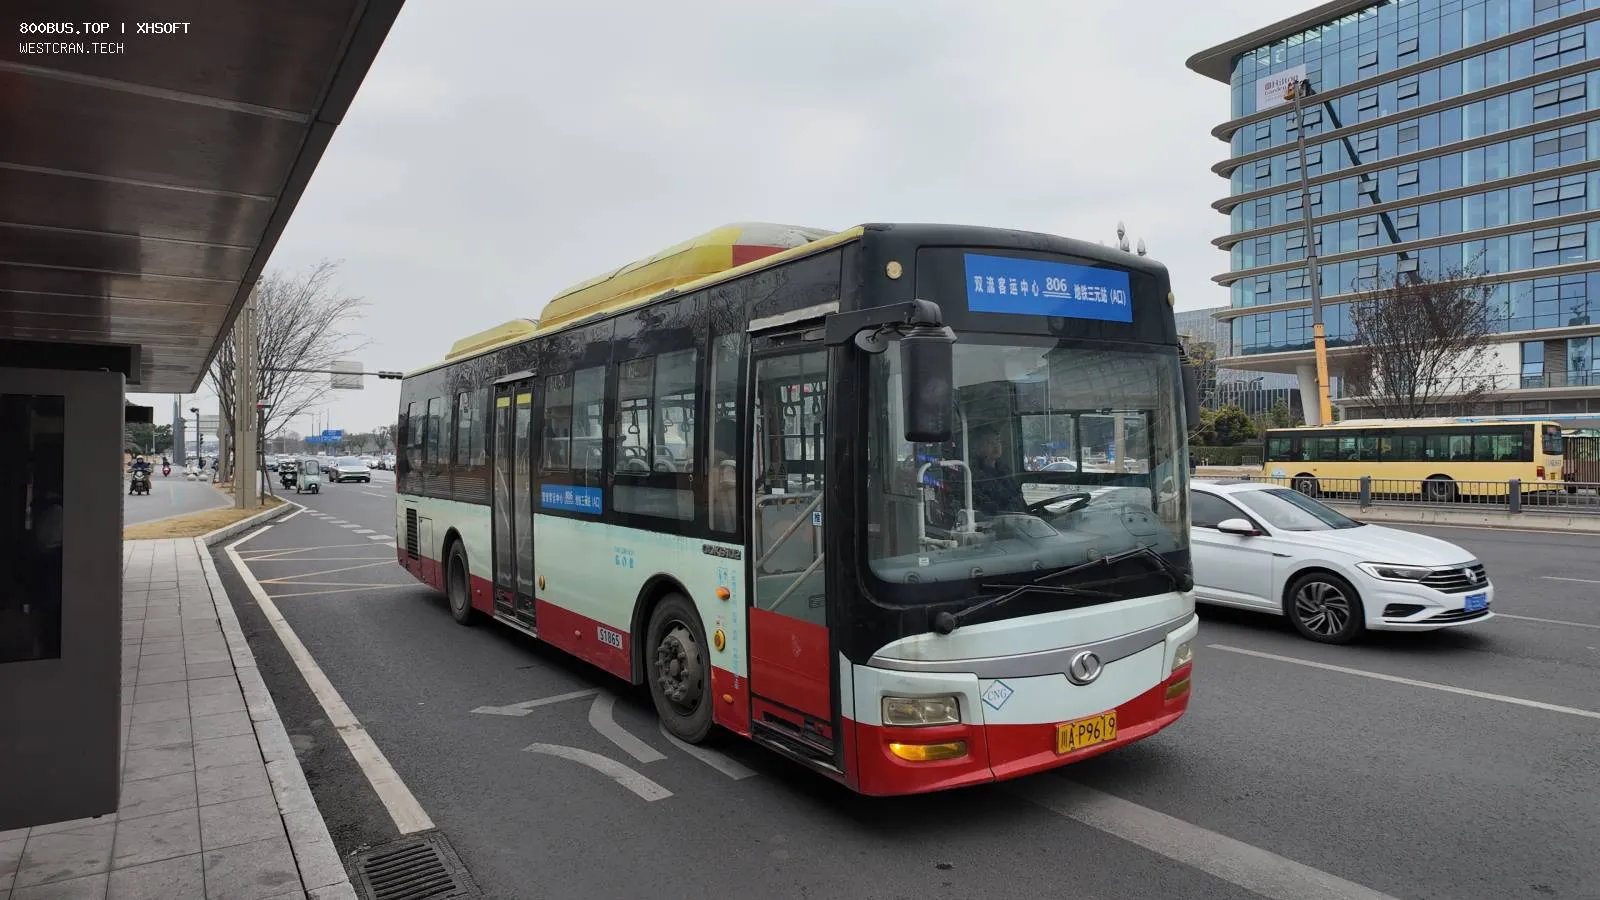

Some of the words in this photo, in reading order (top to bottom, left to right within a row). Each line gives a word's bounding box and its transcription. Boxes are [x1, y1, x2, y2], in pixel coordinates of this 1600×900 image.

[974, 275, 1039, 297] 双流客运中心
[1046, 277, 1067, 292] 806
[600, 628, 620, 645] S1865
[987, 688, 1007, 701] CNG
